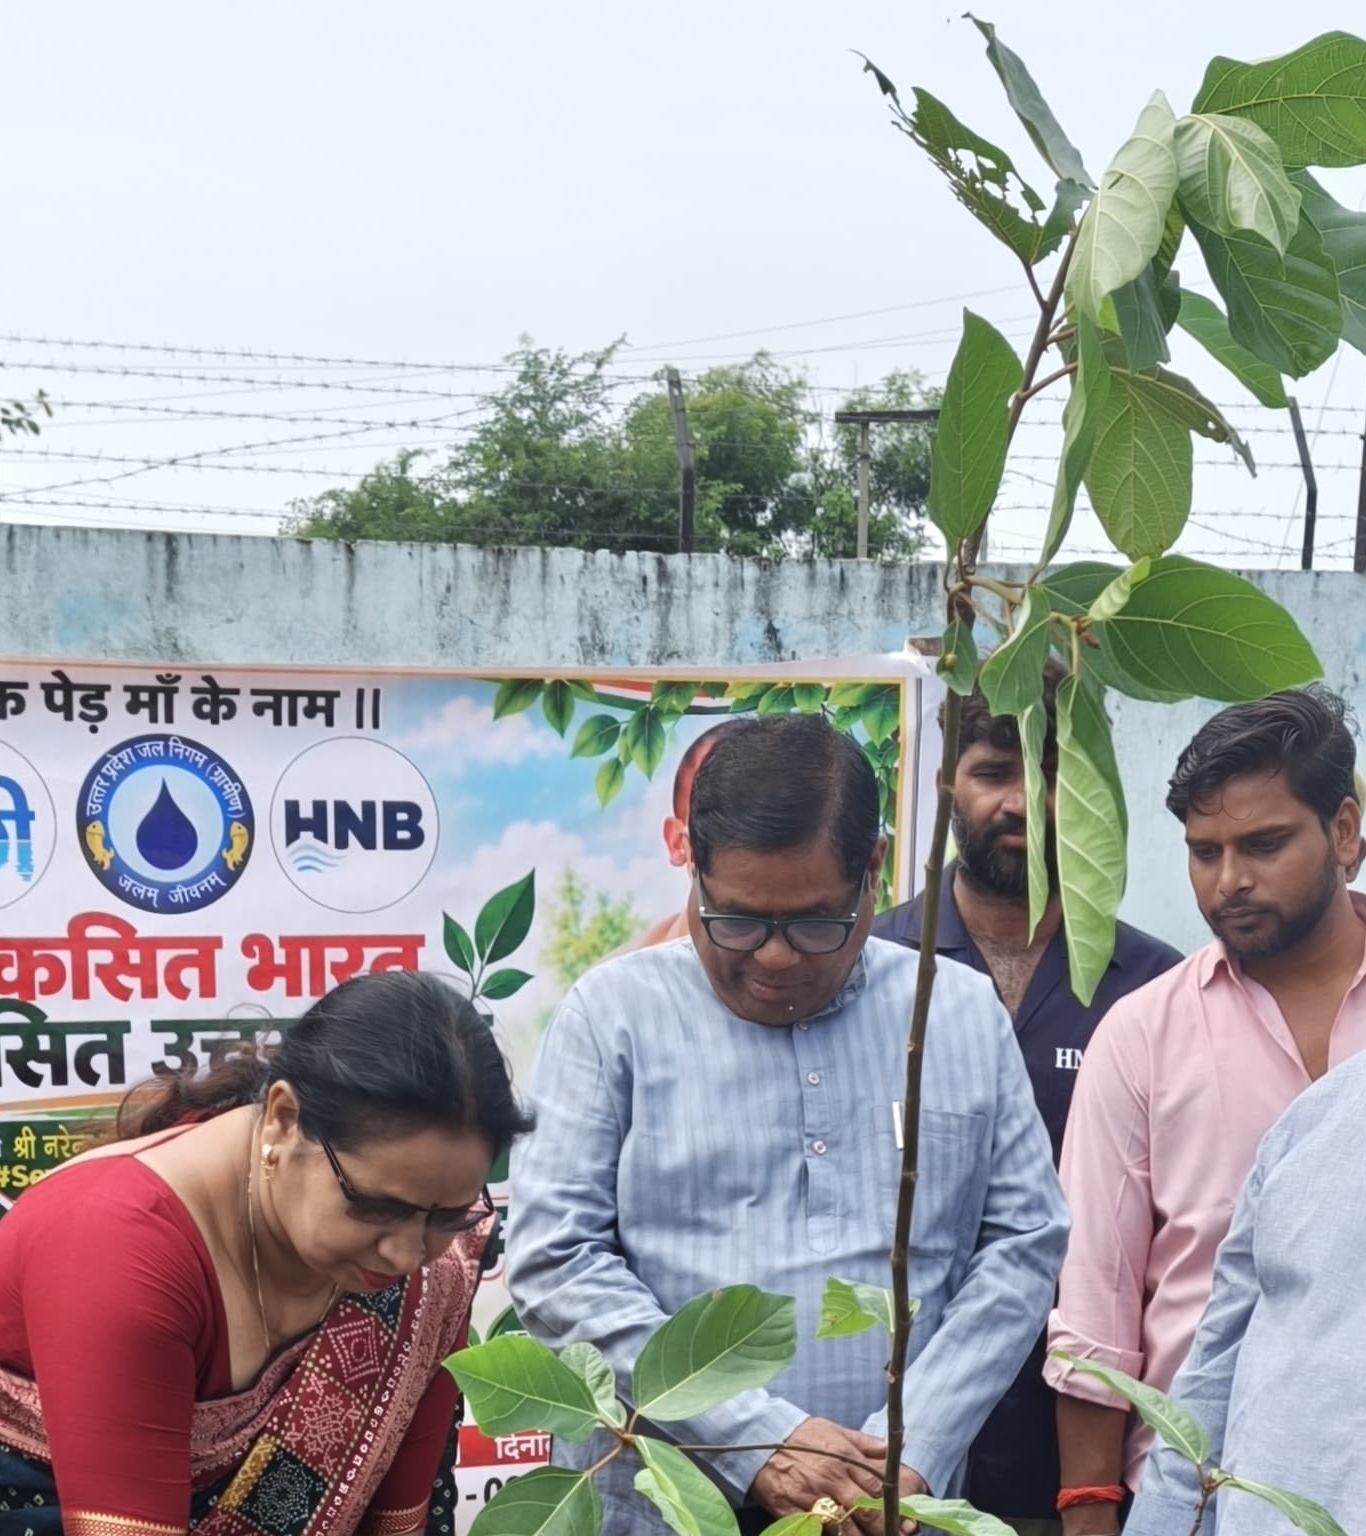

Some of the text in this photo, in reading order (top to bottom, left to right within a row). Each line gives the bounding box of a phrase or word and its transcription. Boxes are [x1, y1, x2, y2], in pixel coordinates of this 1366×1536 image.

[40, 669, 112, 734] पेड़
[123, 672, 183, 724] माँ
[190, 674, 241, 726] के
[250, 688, 341, 728] नाम
[135, 740, 165, 759] जल
[168, 736, 209, 768] निगम
[284, 799, 425, 851] HNB
[118, 873, 160, 908] जलम्
[13, 1125, 36, 1159] श्री
